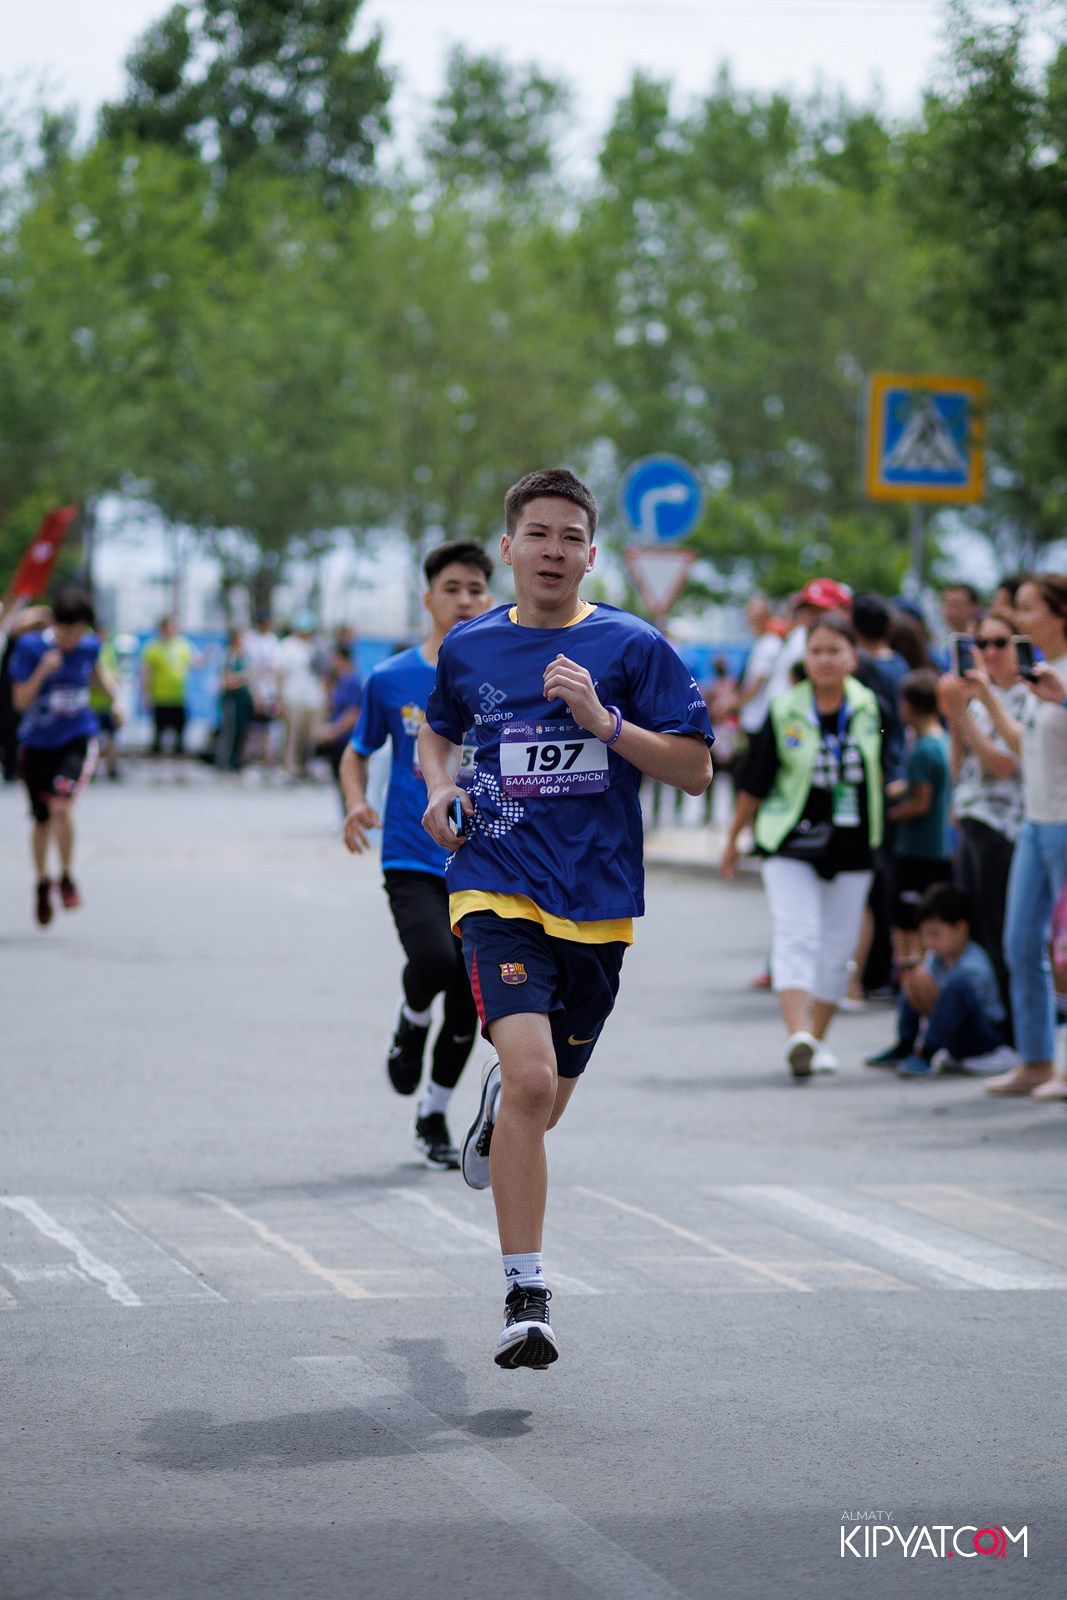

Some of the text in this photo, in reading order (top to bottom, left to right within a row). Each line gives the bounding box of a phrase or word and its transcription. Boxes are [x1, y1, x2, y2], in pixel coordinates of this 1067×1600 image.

[482, 712, 514, 723] GROUP
[526, 743, 584, 772] 197
[505, 772, 604, 786] БАЛАЛАР ЖАРЫСЫ
[539, 785, 560, 794] 600
